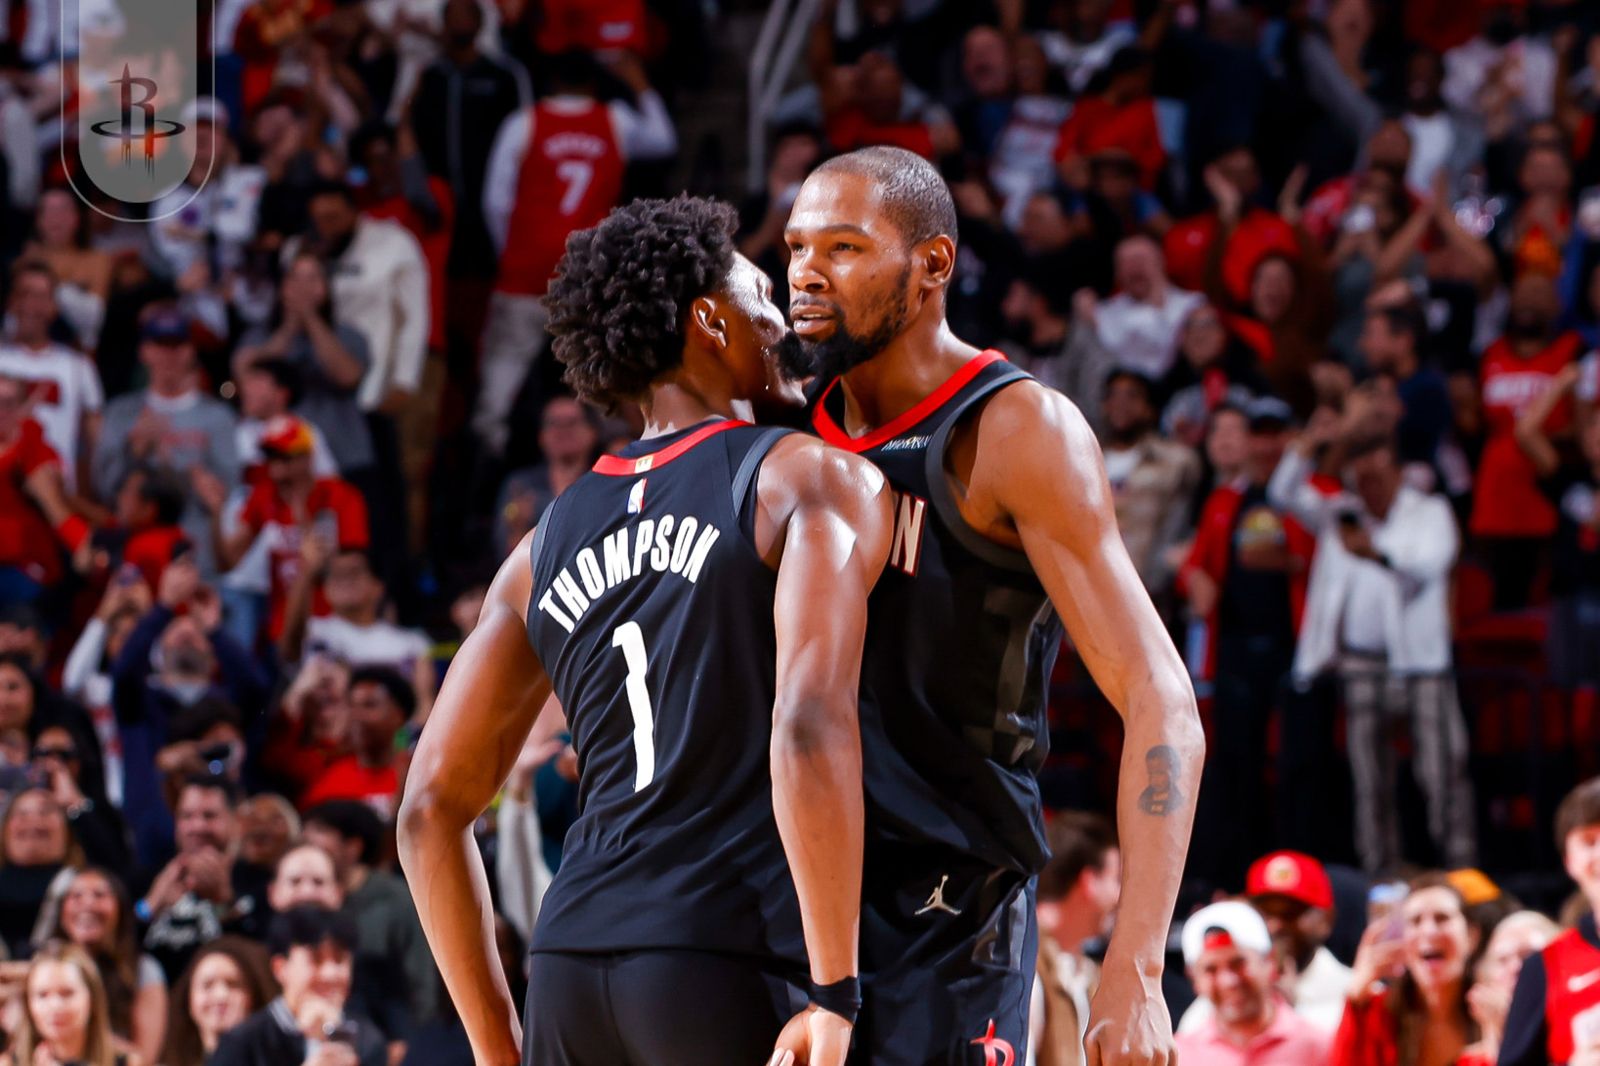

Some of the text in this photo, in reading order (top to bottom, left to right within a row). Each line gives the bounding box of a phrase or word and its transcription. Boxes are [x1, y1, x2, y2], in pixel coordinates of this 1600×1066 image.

[556, 161, 594, 214] 7
[538, 514, 720, 634] THOMPSON
[612, 620, 655, 793] 1
